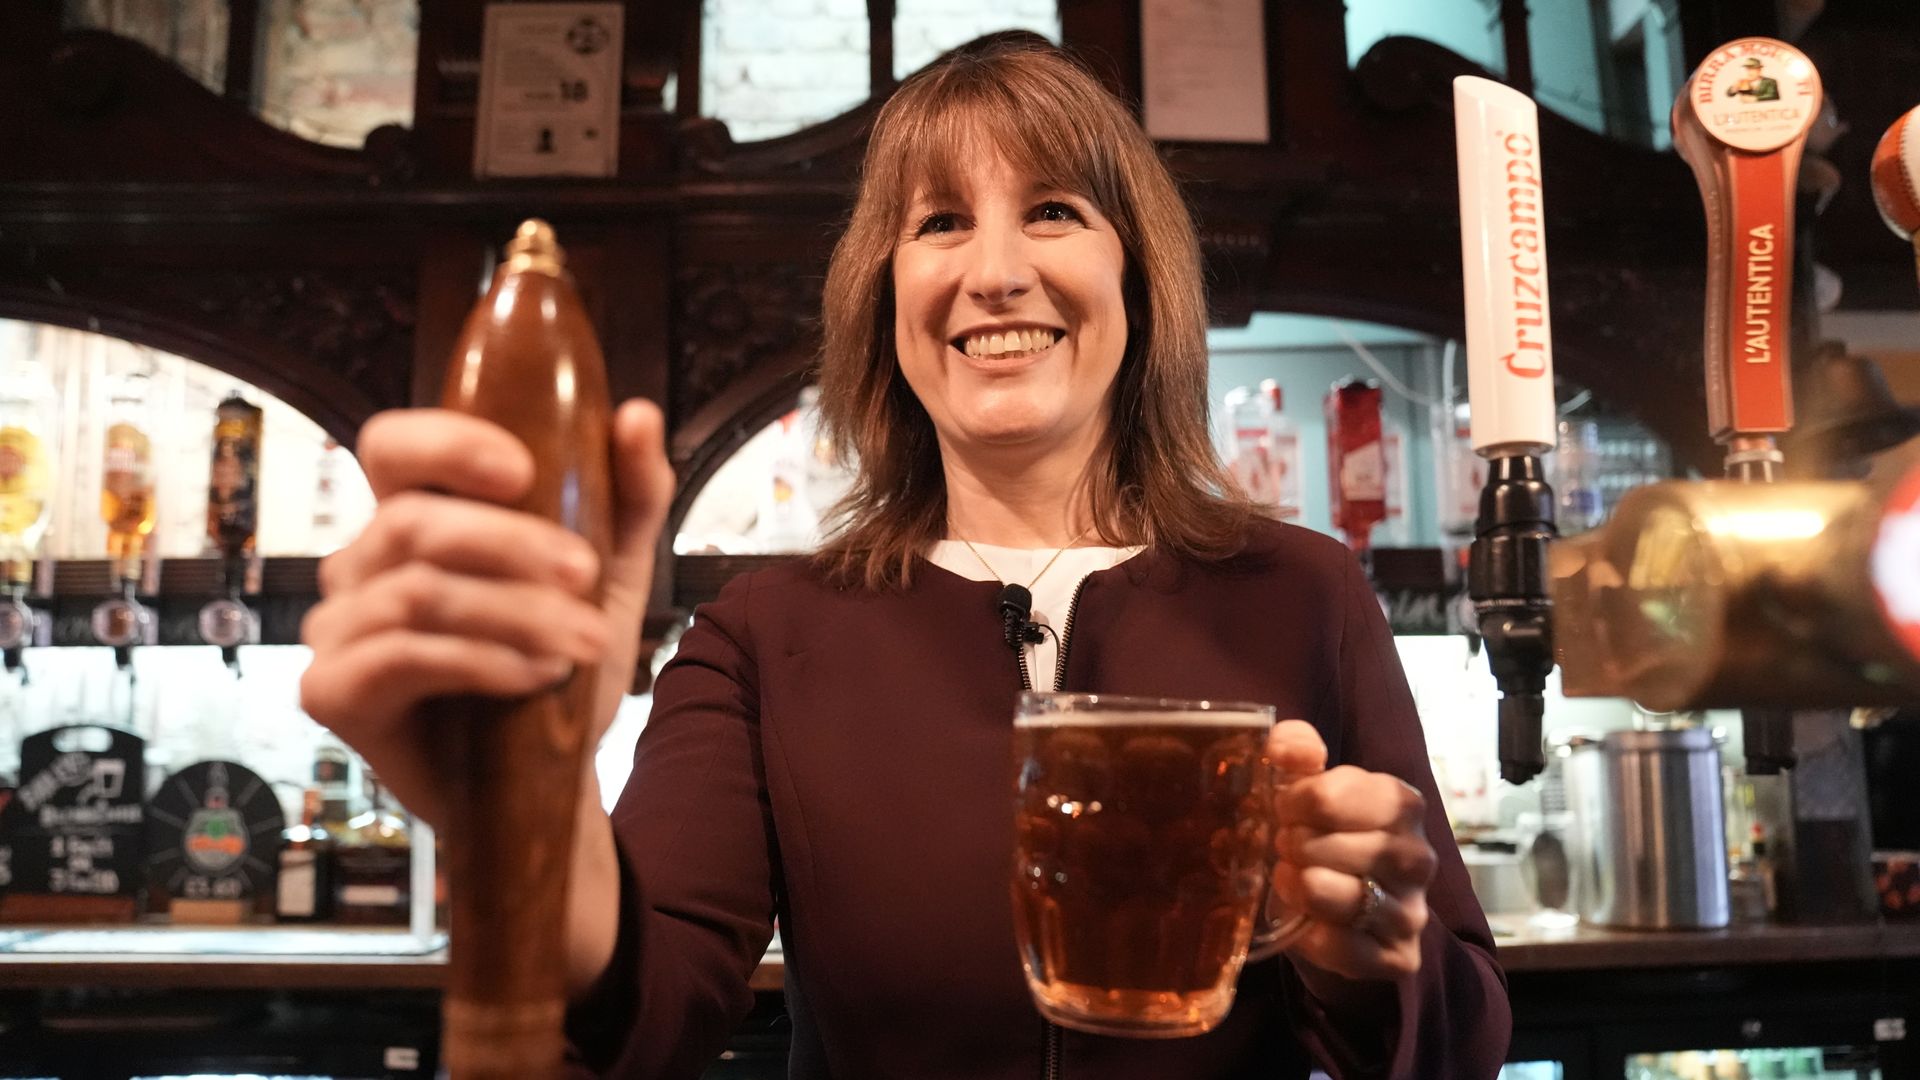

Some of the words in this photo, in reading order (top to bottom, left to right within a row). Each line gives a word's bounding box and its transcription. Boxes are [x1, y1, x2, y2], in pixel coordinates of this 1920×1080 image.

[1698, 49, 1737, 104] BIRRA
[1499, 132, 1547, 380] Cruzcampo
[1744, 222, 1775, 365] L'AUTENTICA
